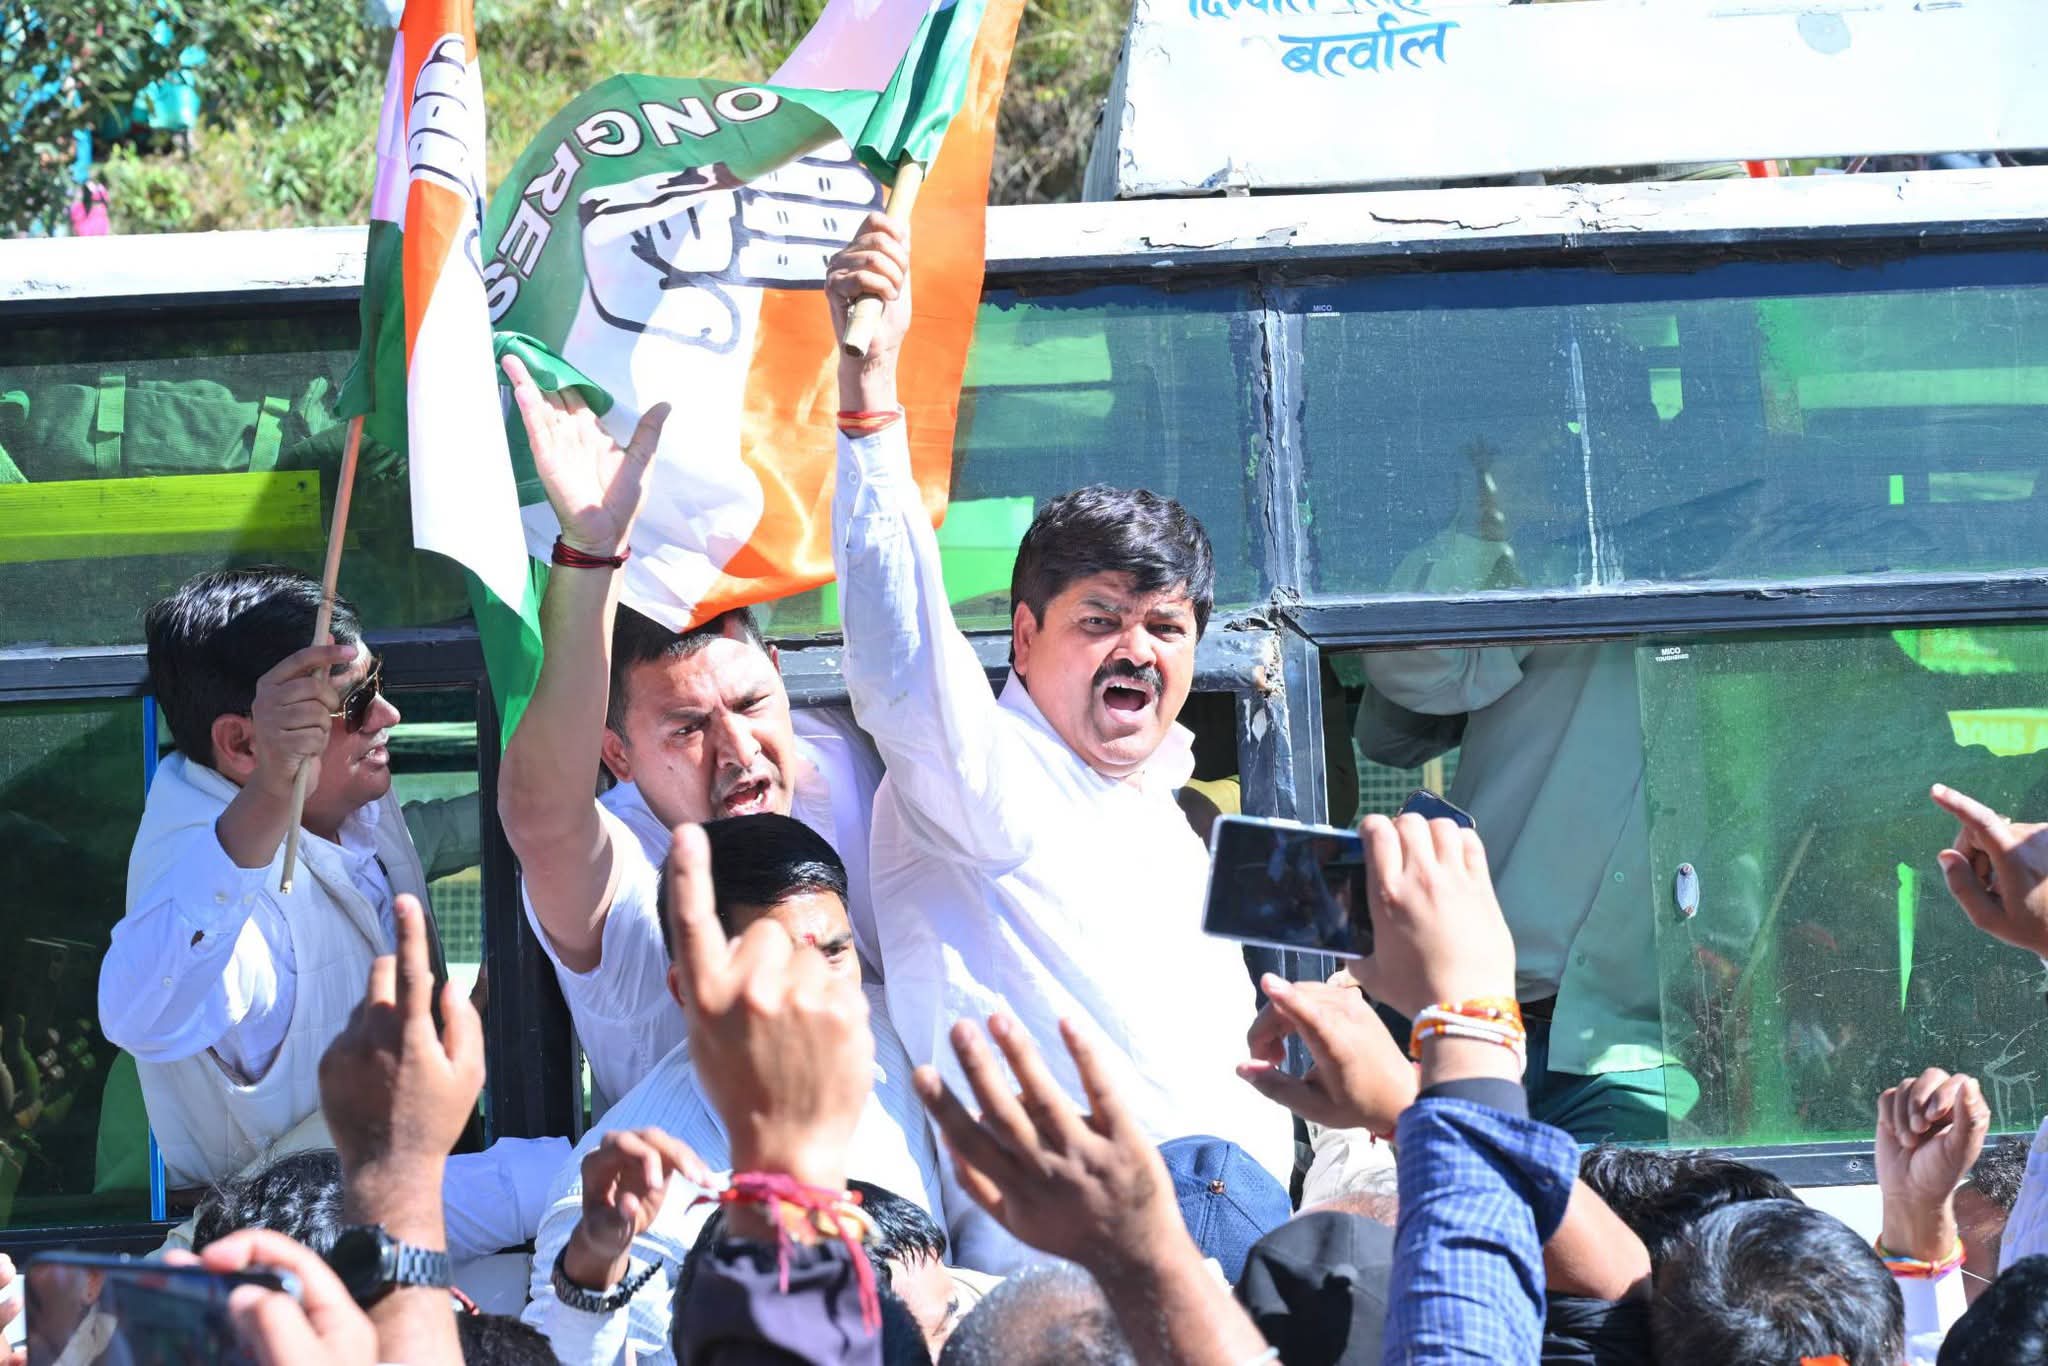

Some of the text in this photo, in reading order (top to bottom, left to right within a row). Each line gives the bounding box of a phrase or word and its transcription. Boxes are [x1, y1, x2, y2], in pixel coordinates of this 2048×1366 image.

[483, 86, 783, 326] ONGRES
[1312, 304, 1333, 312] MICO
[1661, 647, 1681, 656] MICO
